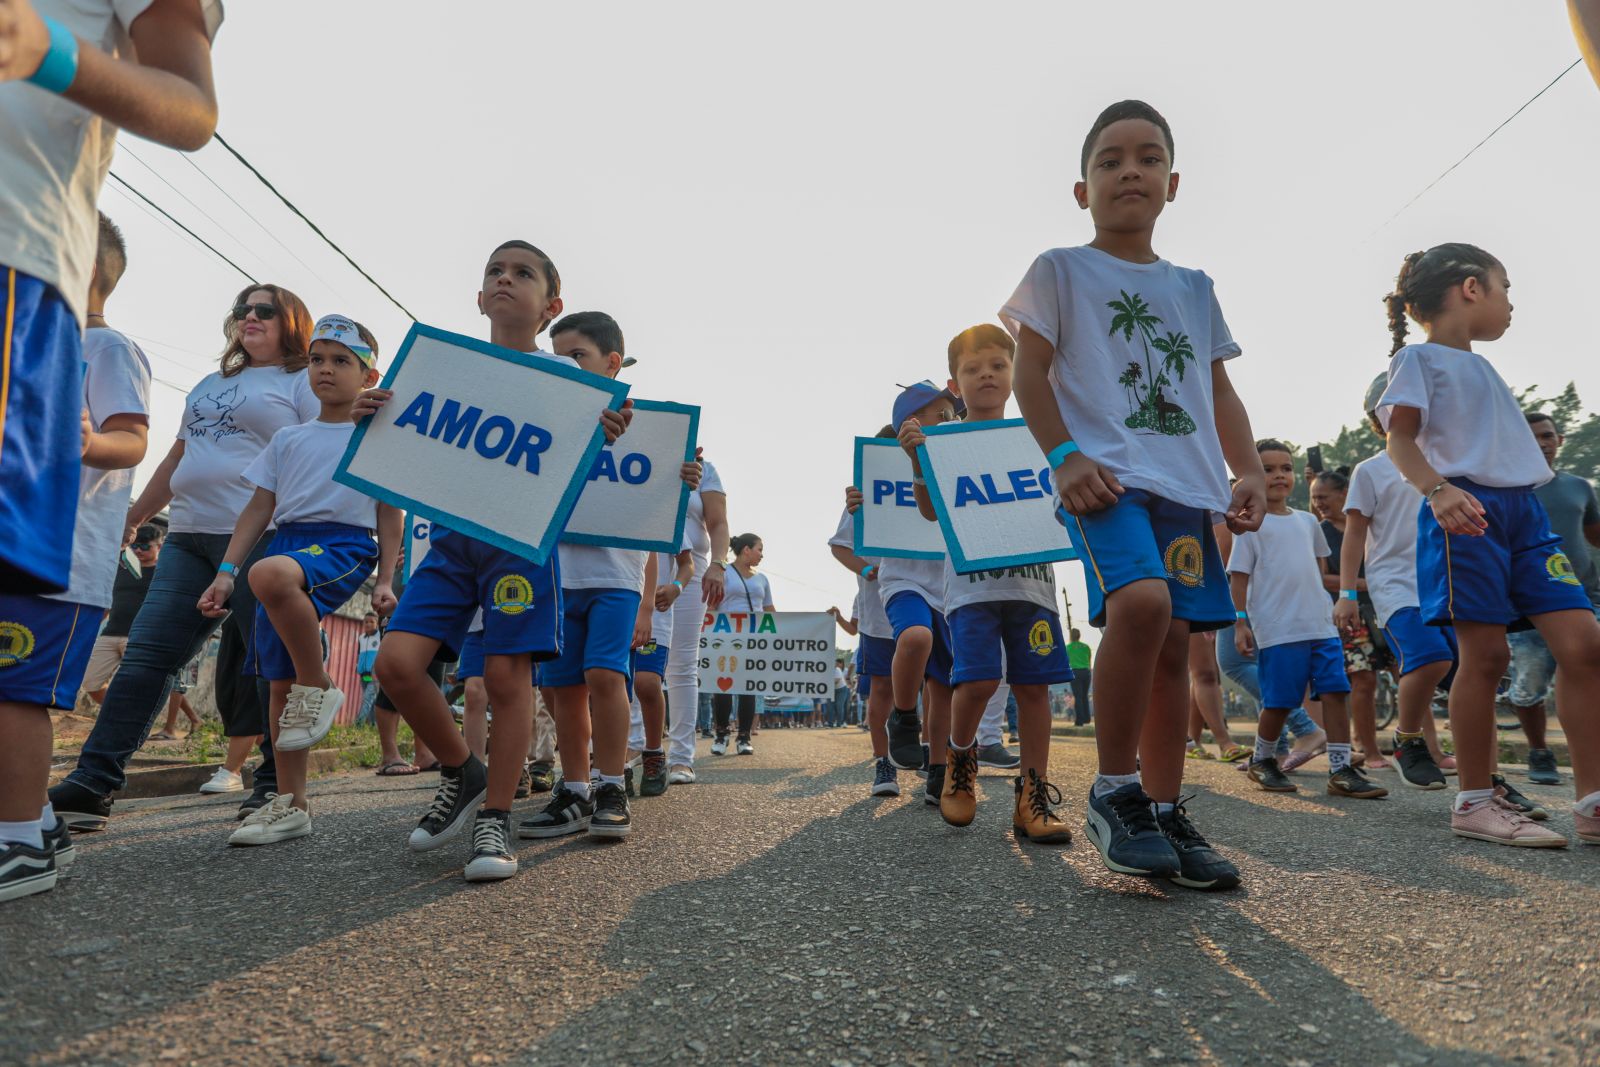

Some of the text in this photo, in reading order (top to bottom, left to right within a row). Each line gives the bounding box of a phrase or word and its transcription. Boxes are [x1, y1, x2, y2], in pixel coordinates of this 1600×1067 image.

[394, 391, 552, 475] AMOR
[701, 612, 777, 634] PATIA
[747, 638, 829, 651] DO OUTRO
[745, 659, 828, 673] DO OUTRO
[745, 680, 828, 694] DO OUTRO
